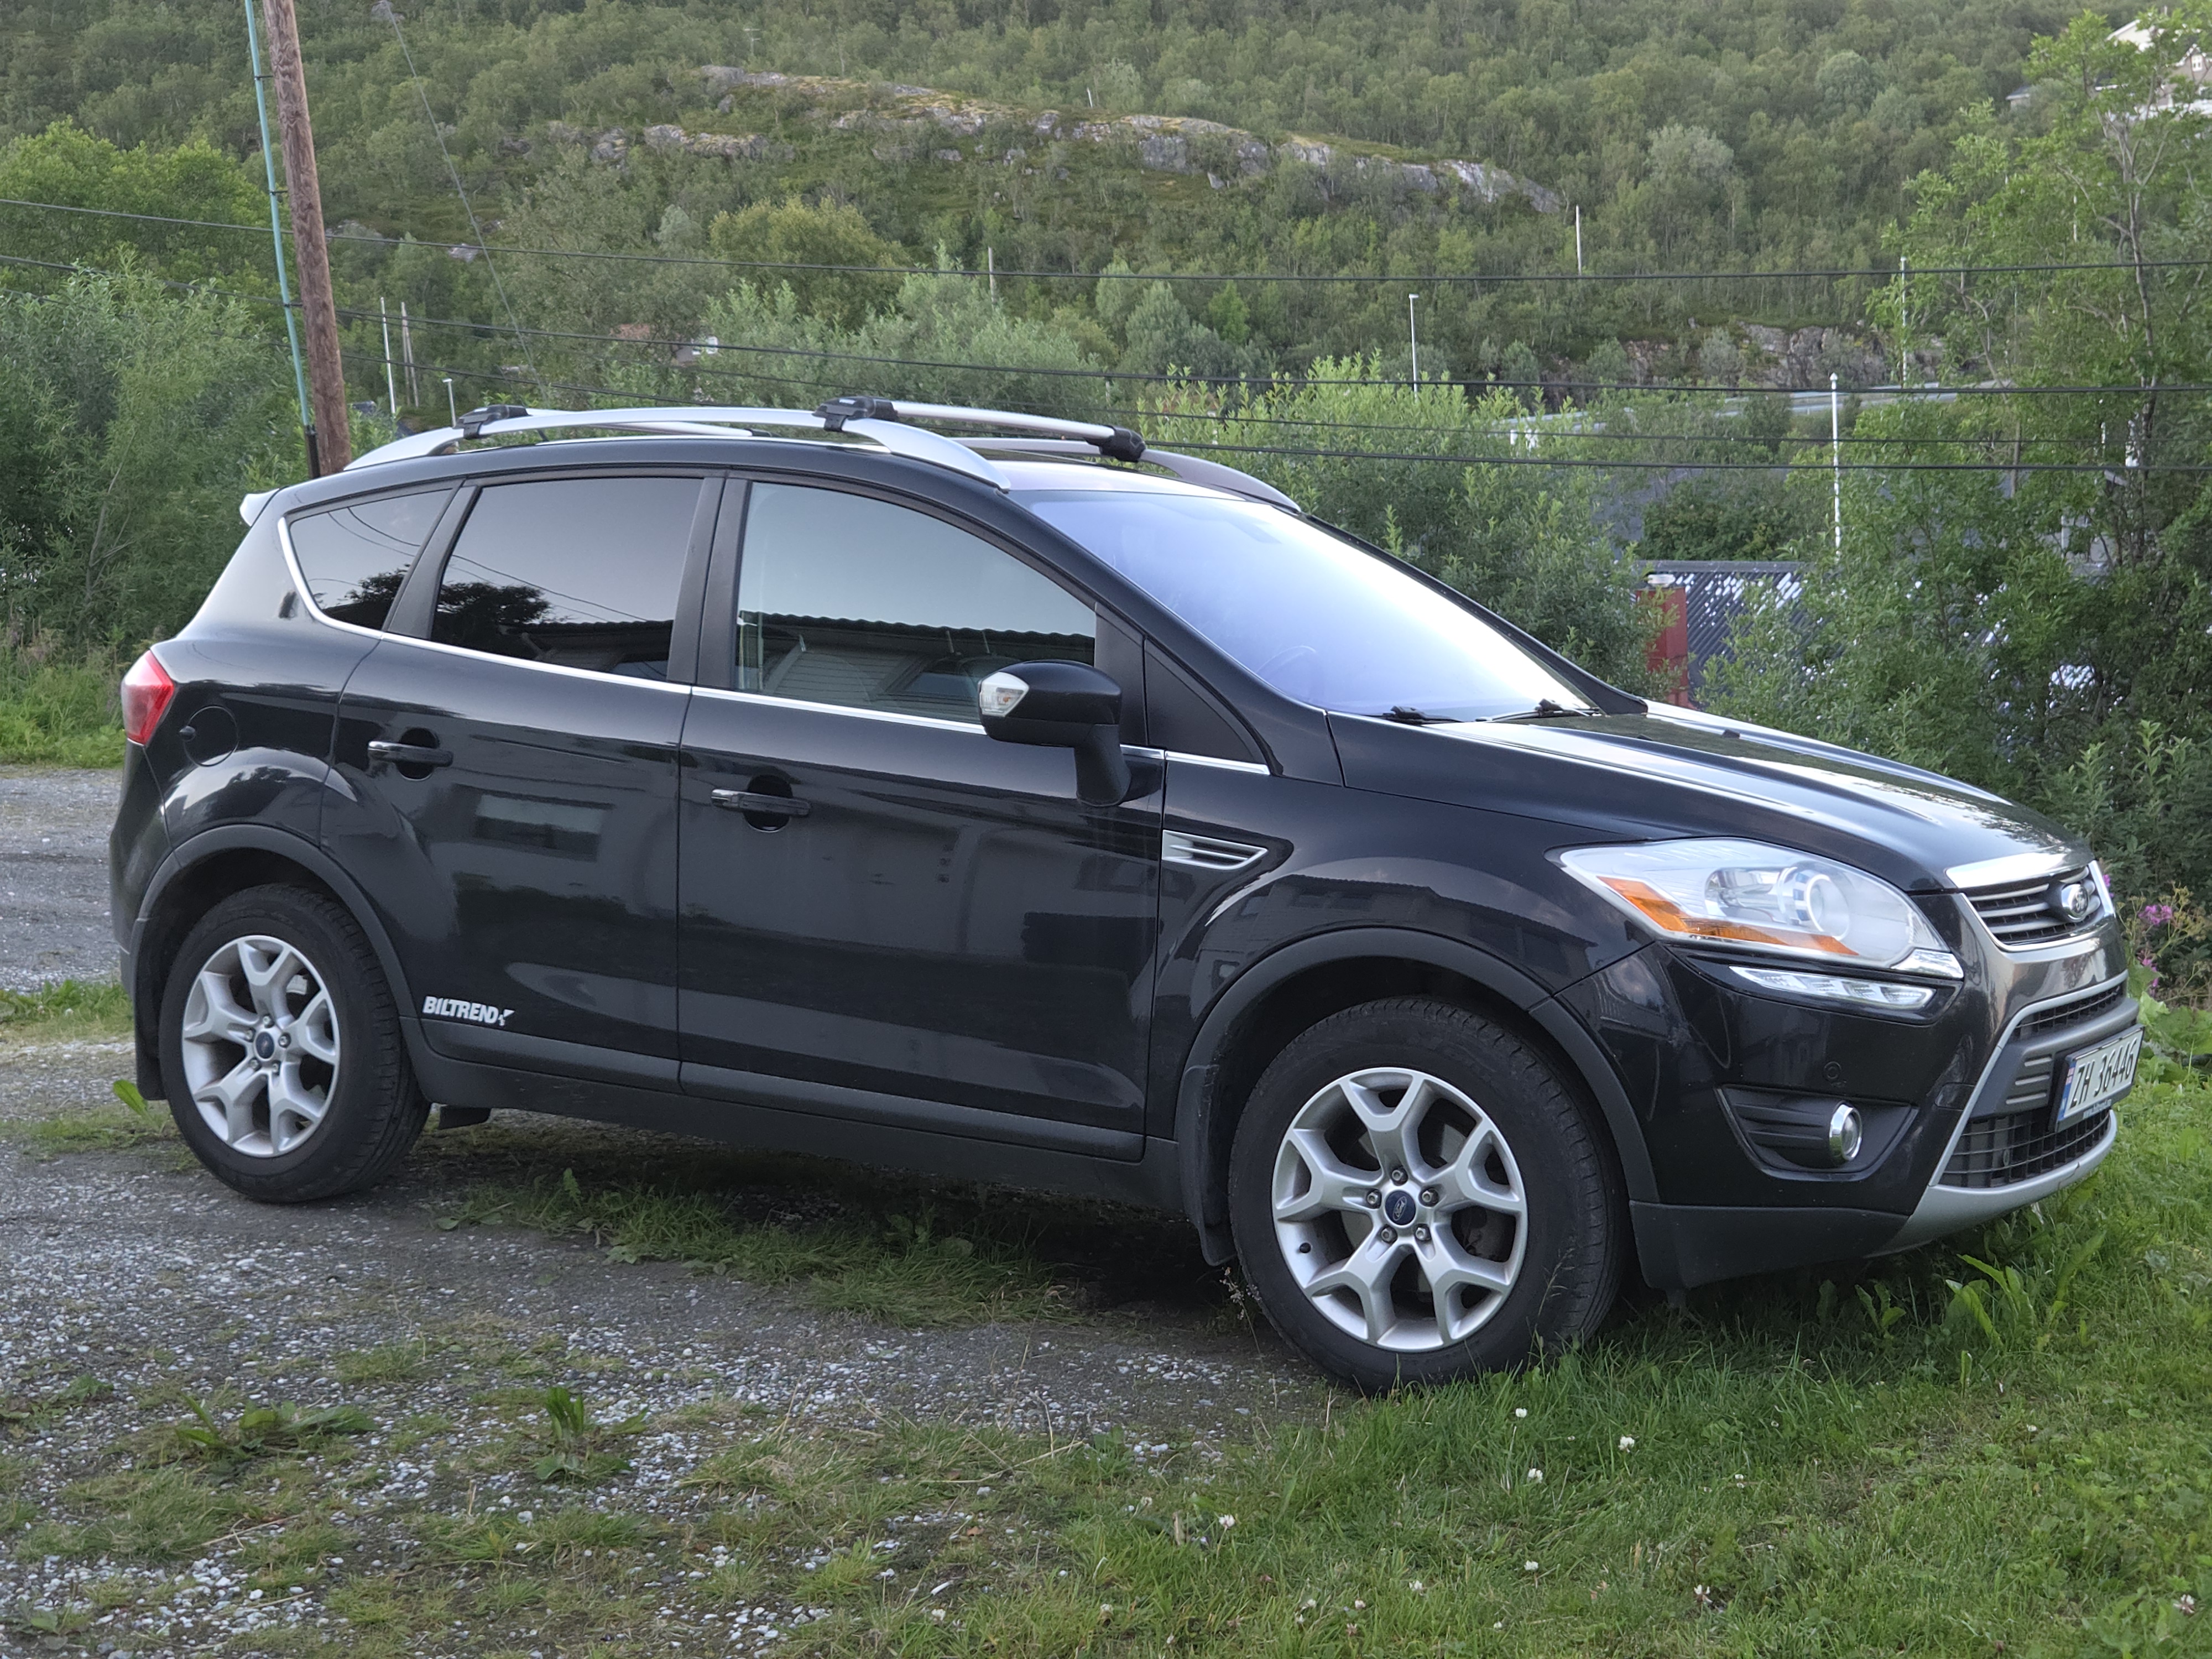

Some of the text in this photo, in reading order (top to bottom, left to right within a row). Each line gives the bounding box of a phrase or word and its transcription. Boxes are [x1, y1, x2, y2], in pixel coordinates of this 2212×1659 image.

[422, 995, 499, 1024] BILTREND
[2070, 1037, 2137, 1109] ZH 36446
